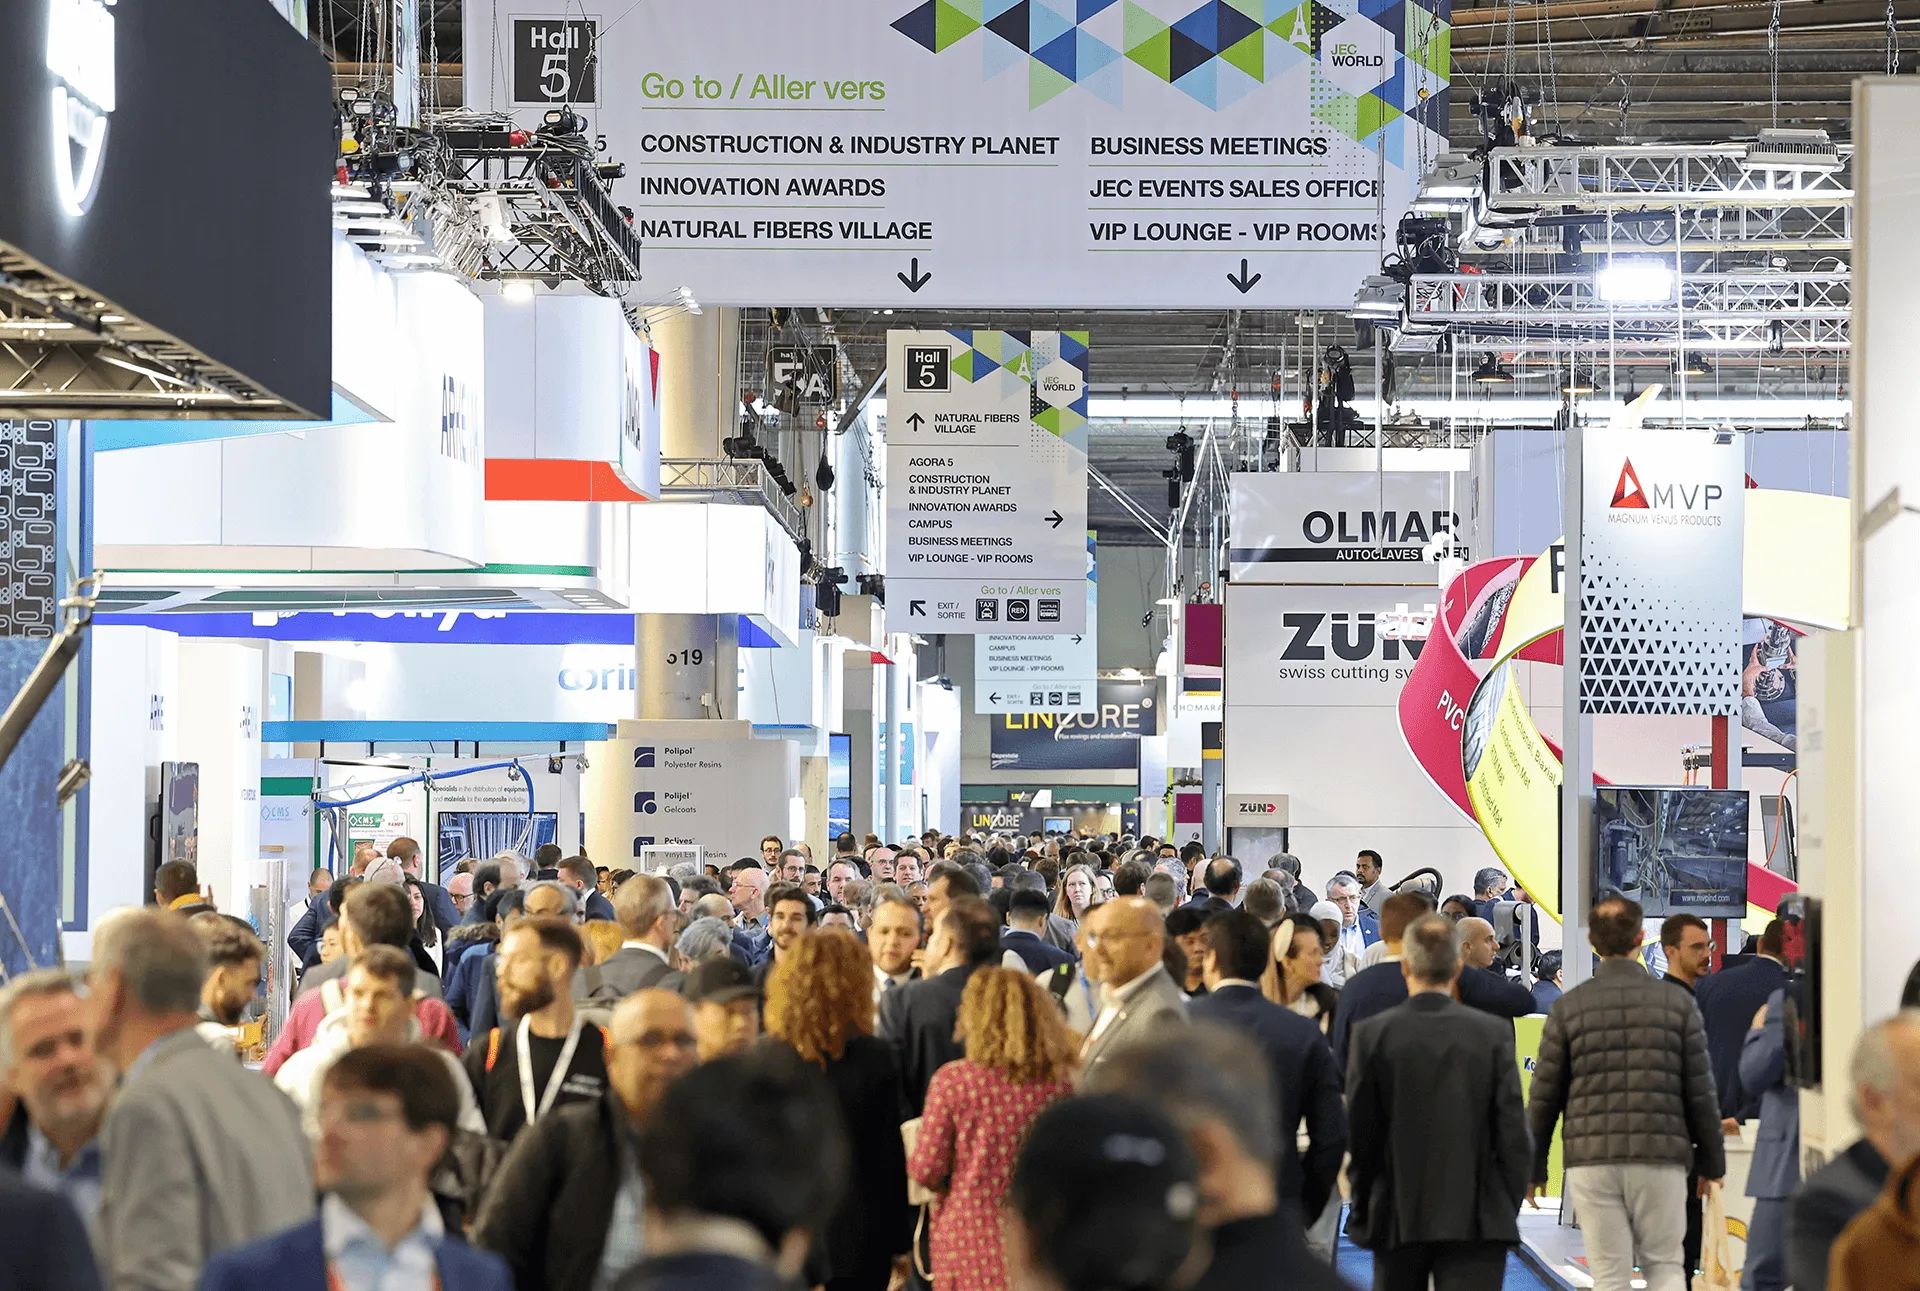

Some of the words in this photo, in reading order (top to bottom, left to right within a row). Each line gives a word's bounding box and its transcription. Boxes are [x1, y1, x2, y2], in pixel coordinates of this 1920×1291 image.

[530, 27, 580, 50] Hall
[1331, 44, 1358, 56] JEC
[1331, 55, 1384, 68] WORLD
[539, 54, 572, 99] 5
[641, 73, 688, 101] Go
[692, 75, 723, 101] to
[730, 73, 743, 101] /
[750, 72, 820, 101] Aller
[824, 78, 886, 101] vers
[641, 134, 824, 155] CONSTRUCTION
[829, 135, 845, 155] &
[851, 135, 968, 155] INDUSTRY
[973, 136, 1060, 156] PLANET
[1091, 137, 1205, 156] BUSINESS
[1209, 137, 1329, 156] MEETINGS
[641, 177, 781, 197] INNOVATION
[786, 177, 886, 198] AWARDS
[1090, 179, 1134, 199] JEC
[1139, 179, 1225, 199] EVENTS
[1229, 180, 1301, 199] SALES
[1305, 180, 1386, 199] OFFICE
[641, 220, 749, 240] NATURAL
[754, 220, 834, 240] FIBERS
[838, 221, 932, 241] VILLAGE
[1090, 222, 1128, 242] VIP
[1133, 222, 1232, 242] LOUNGE
[1252, 222, 1292, 242] VIP
[1297, 223, 1386, 243] ROOMS
[915, 351, 940, 363] Hall
[919, 365, 936, 387] 5
[1043, 376, 1059, 384] JEC
[1043, 384, 1076, 392] WORLD
[934, 413, 983, 423] NATURAL
[985, 414, 1020, 423] FIBERS
[934, 424, 976, 434] VILLAGE
[909, 458, 945, 467] AGORA
[947, 458, 954, 467] 5
[909, 474, 990, 484] CONSTRUCTION
[909, 486, 916, 495] &
[918, 486, 970, 495] INDUSTRY
[972, 486, 1011, 495] PLANET
[908, 503, 971, 512] INNOVATION
[973, 503, 1017, 512] AWARDS
[908, 519, 953, 529] CAMPUS
[1608, 513, 1648, 524] MAGNUM
[1651, 515, 1678, 525] VENUS
[1681, 515, 1721, 526] PRODUCTS
[1303, 511, 1460, 543] OLMAR
[908, 537, 959, 546] BUSINESS
[960, 537, 1013, 546] MEETINGS
[908, 554, 925, 563] VIP
[926, 554, 968, 564] LOUNGE
[977, 554, 993, 563] VIP
[995, 554, 1033, 563] ROOMS
[1336, 549, 1419, 560] AUTOCLAVES
[981, 586, 996, 596] Go
[998, 586, 1008, 595] to
[1017, 585, 1039, 596] Aller
[1040, 588, 1061, 596] vers
[1011, 606, 1025, 614] RER
[1279, 665, 1326, 680] swiss
[1331, 665, 1389, 683] cutting
[1437, 690, 1463, 731] PVC
[664, 761, 697, 769] Polyester
[698, 761, 723, 769] Resins
[358, 816, 375, 824] CMS
